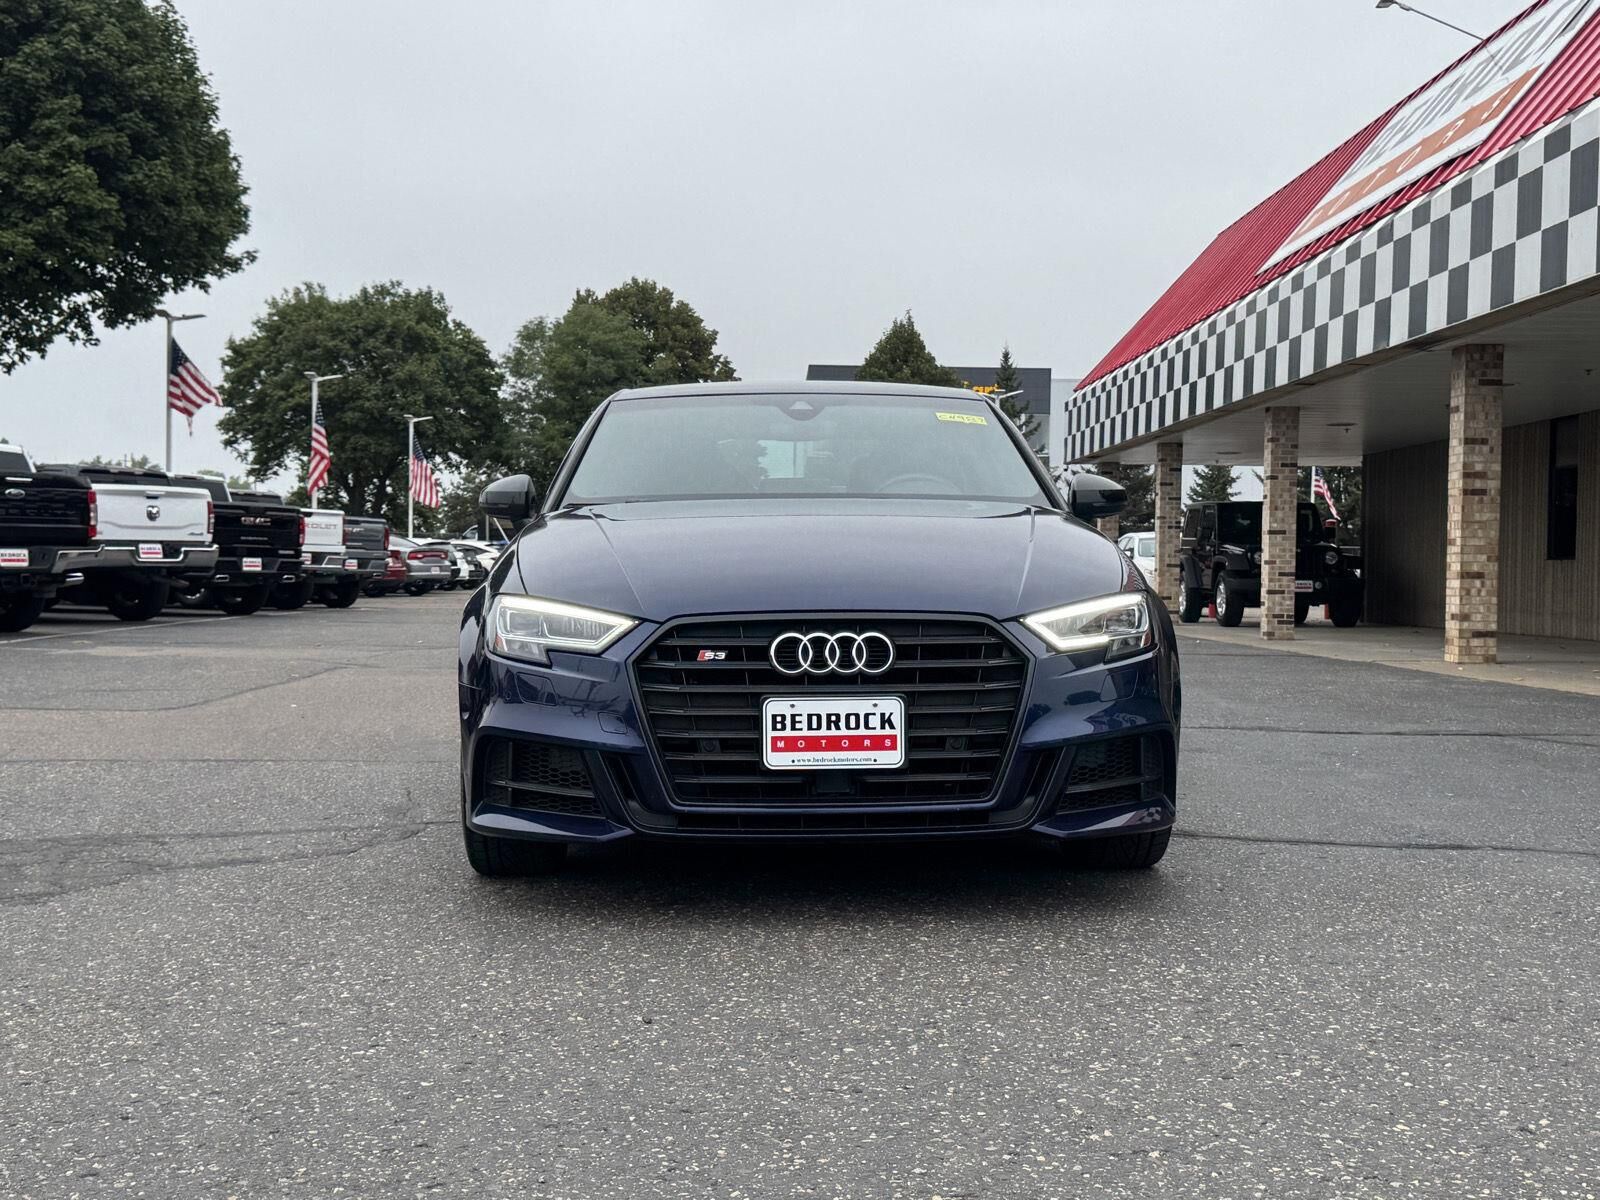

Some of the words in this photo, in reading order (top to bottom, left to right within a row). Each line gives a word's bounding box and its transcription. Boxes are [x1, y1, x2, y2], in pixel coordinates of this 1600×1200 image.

[701, 651, 726, 660] S3
[771, 712, 896, 731] BEDROCK
[777, 739, 891, 748] MOTORS
